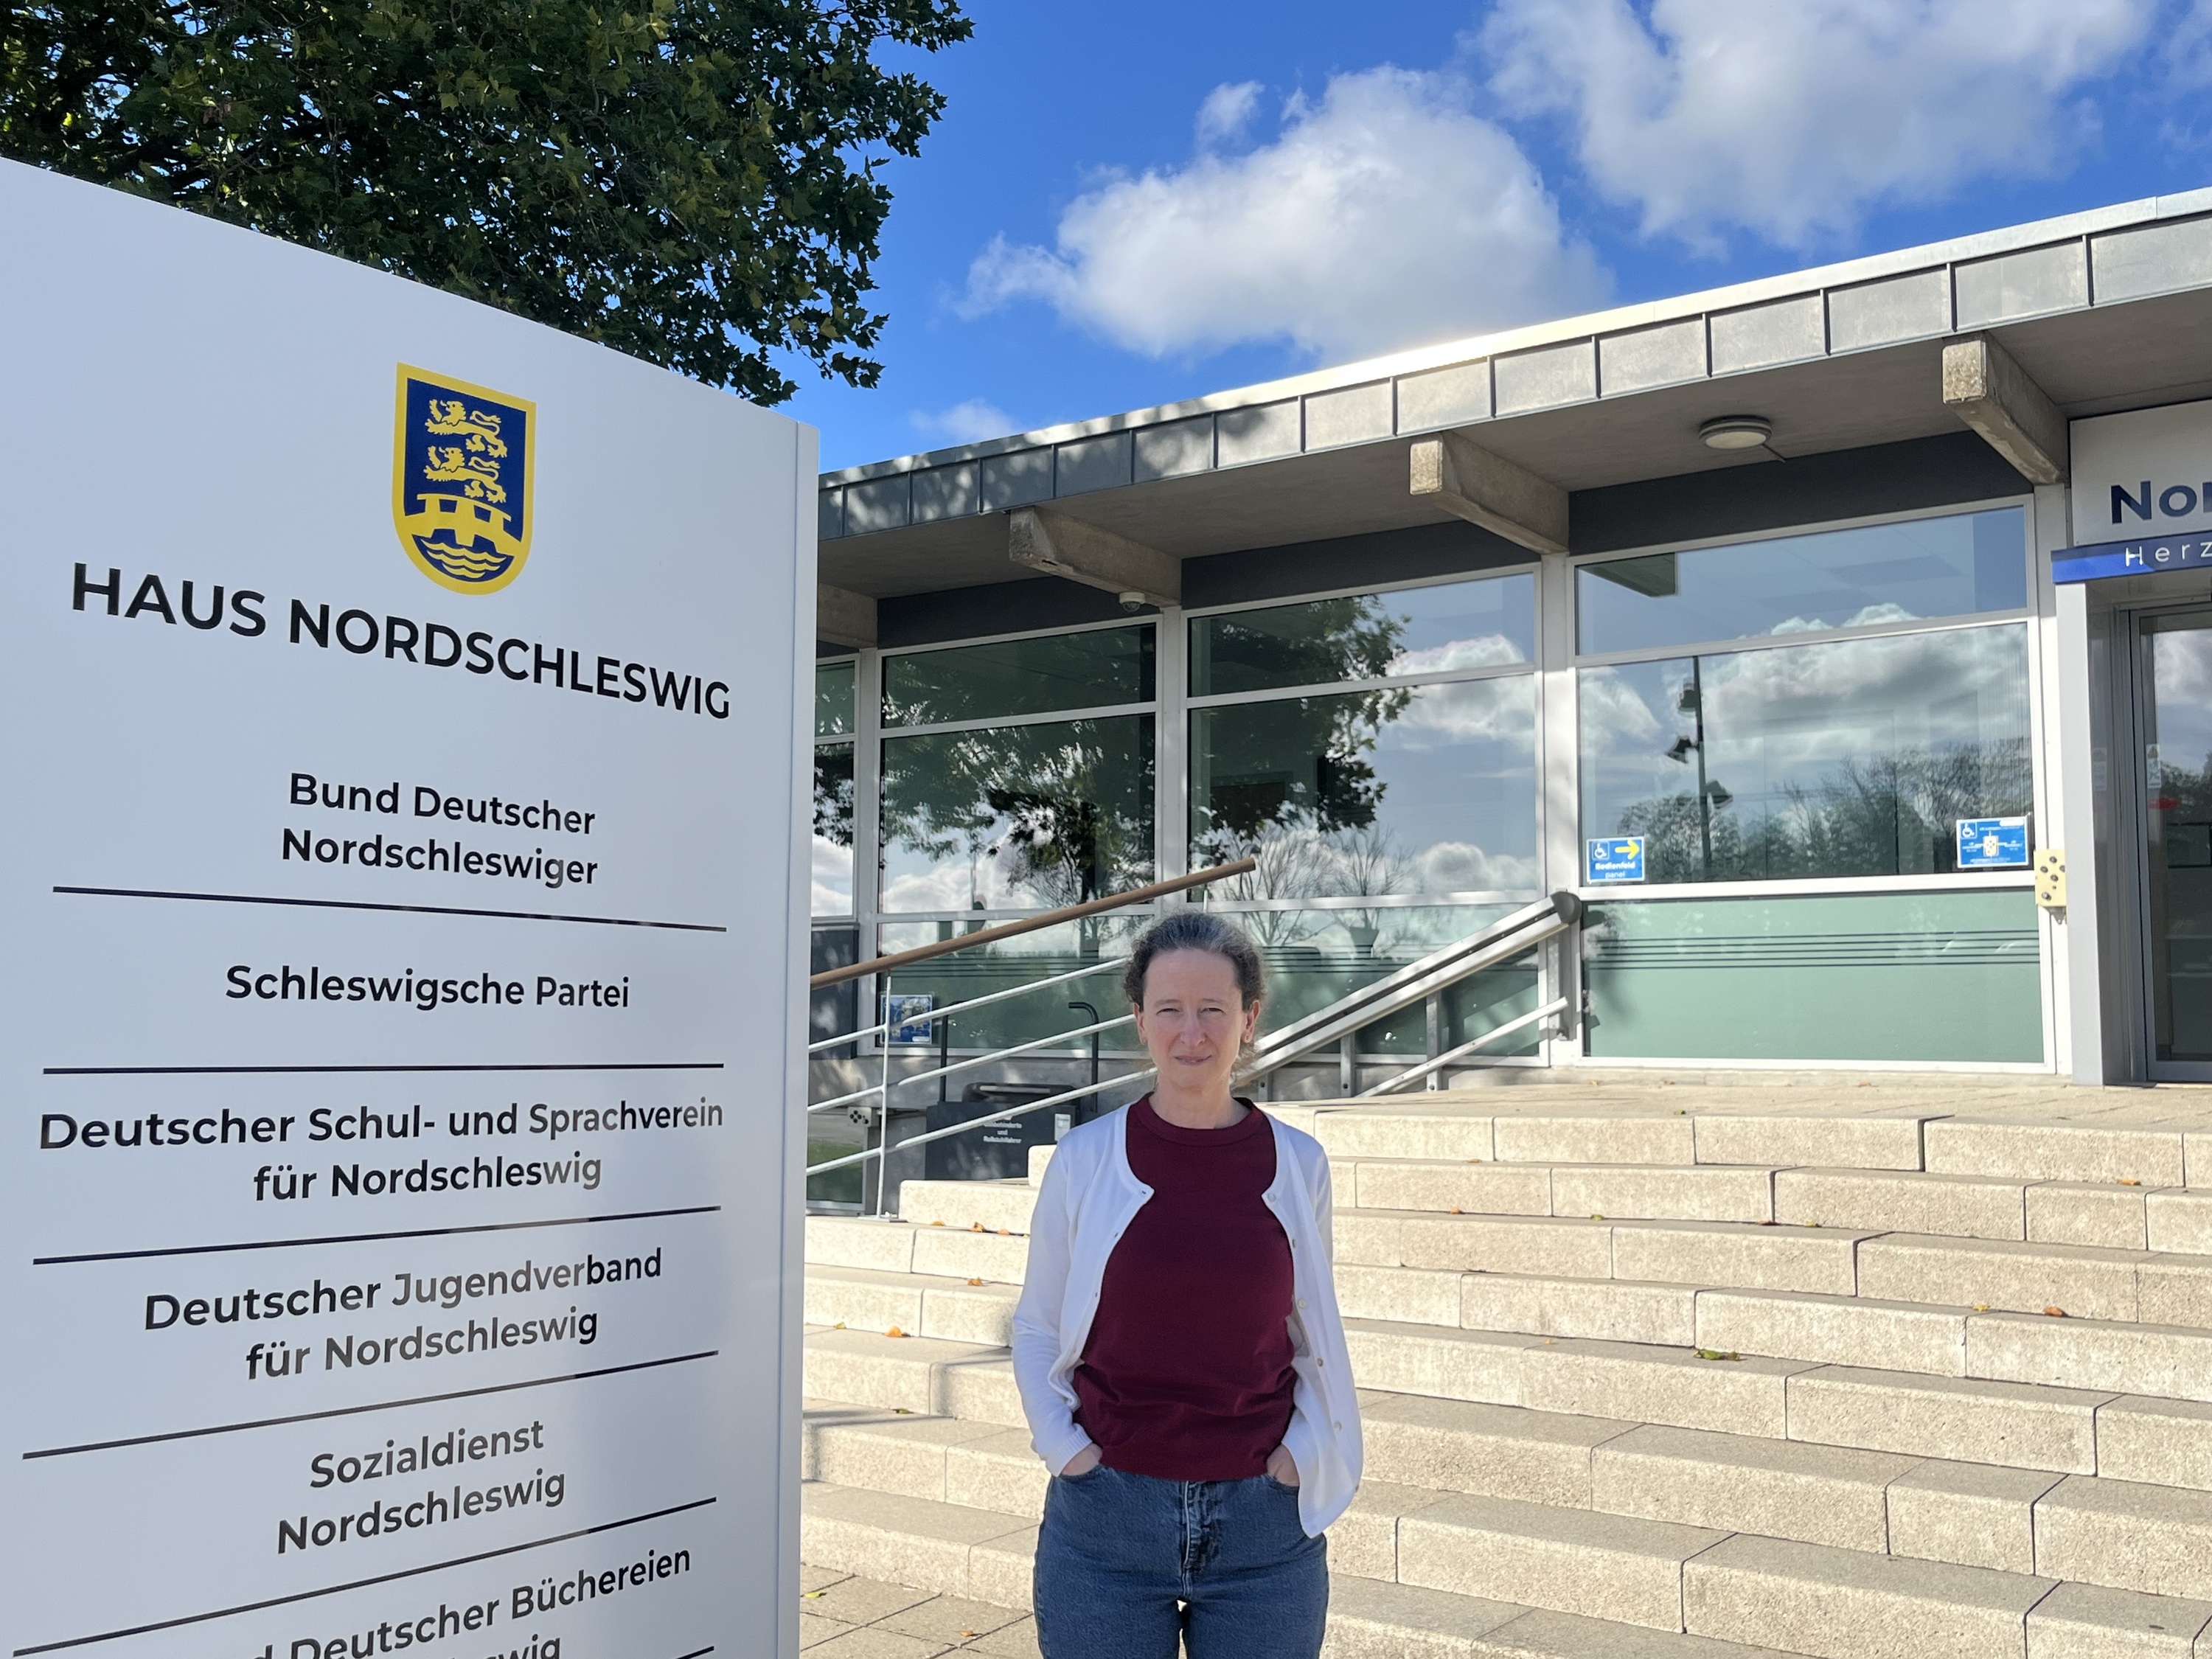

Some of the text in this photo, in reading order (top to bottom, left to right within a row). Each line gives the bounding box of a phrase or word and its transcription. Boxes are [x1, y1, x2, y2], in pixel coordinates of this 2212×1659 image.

[72, 563, 729, 719] HAUS NORDSCHLESWIG
[291, 773, 595, 834] Bund Deutscher
[282, 828, 598, 888] Nordschleswiger
[226, 965, 629, 1011] Schleswigsche Partei
[41, 1096, 722, 1149] Deutscher Schul- und Sprachverein
[254, 1151, 601, 1201] für Nordschleswig
[145, 1247, 661, 1330] Deutscher Jugendverband
[246, 1306, 597, 1380] für Nordschleswig
[310, 1421, 543, 1488] Sozialdienst
[278, 1468, 564, 1554] Nordschleswig
[291, 1549, 689, 1659] Deutscher Büchereien
